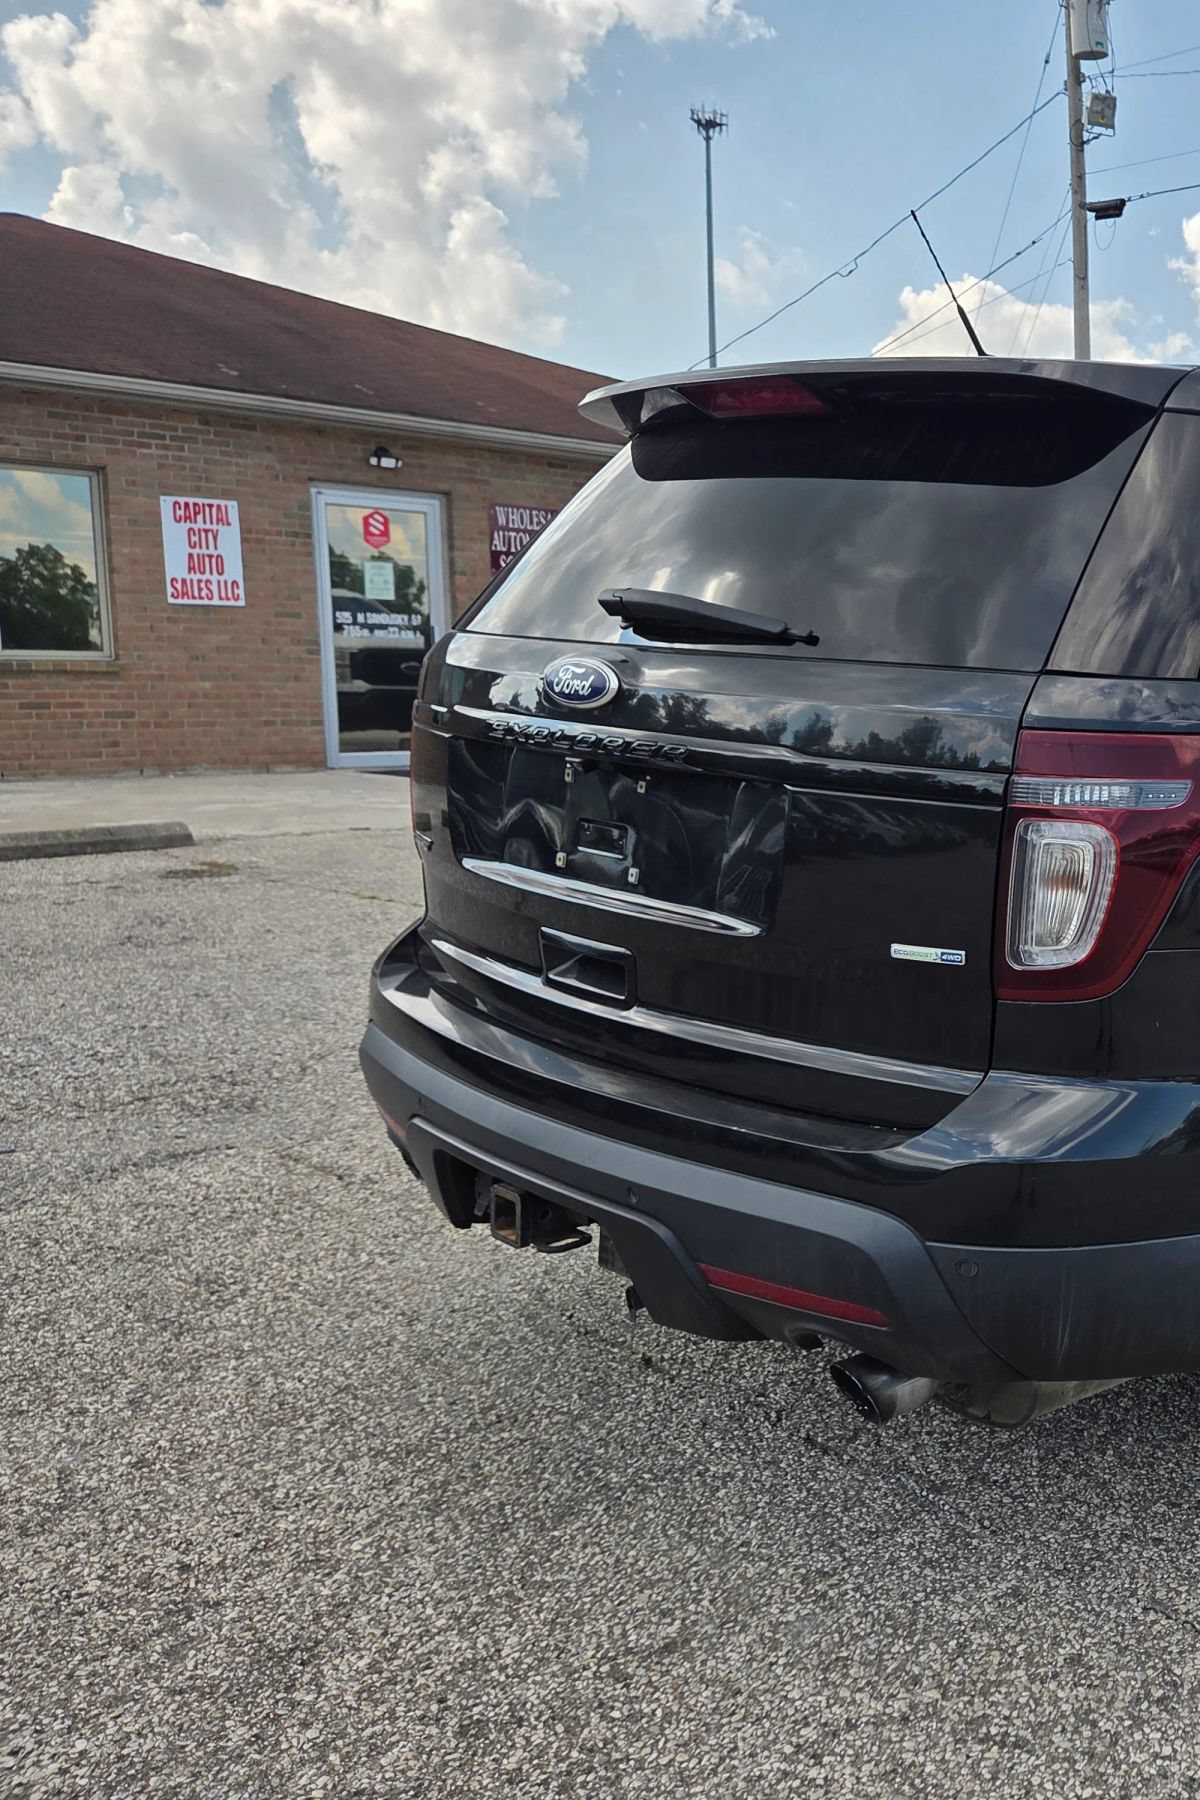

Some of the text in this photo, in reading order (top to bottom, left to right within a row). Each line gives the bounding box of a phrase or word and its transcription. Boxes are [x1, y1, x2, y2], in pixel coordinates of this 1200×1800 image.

[173, 500, 231, 526] CAPITAL
[187, 527, 219, 550] CITY
[491, 530, 530, 552] AUTO
[187, 552, 224, 576] AUTO
[170, 577, 240, 601] SALES LLC
[553, 665, 595, 696] Ford
[487, 718, 690, 763] EXPLORER
[941, 954, 961, 962] 4WD
